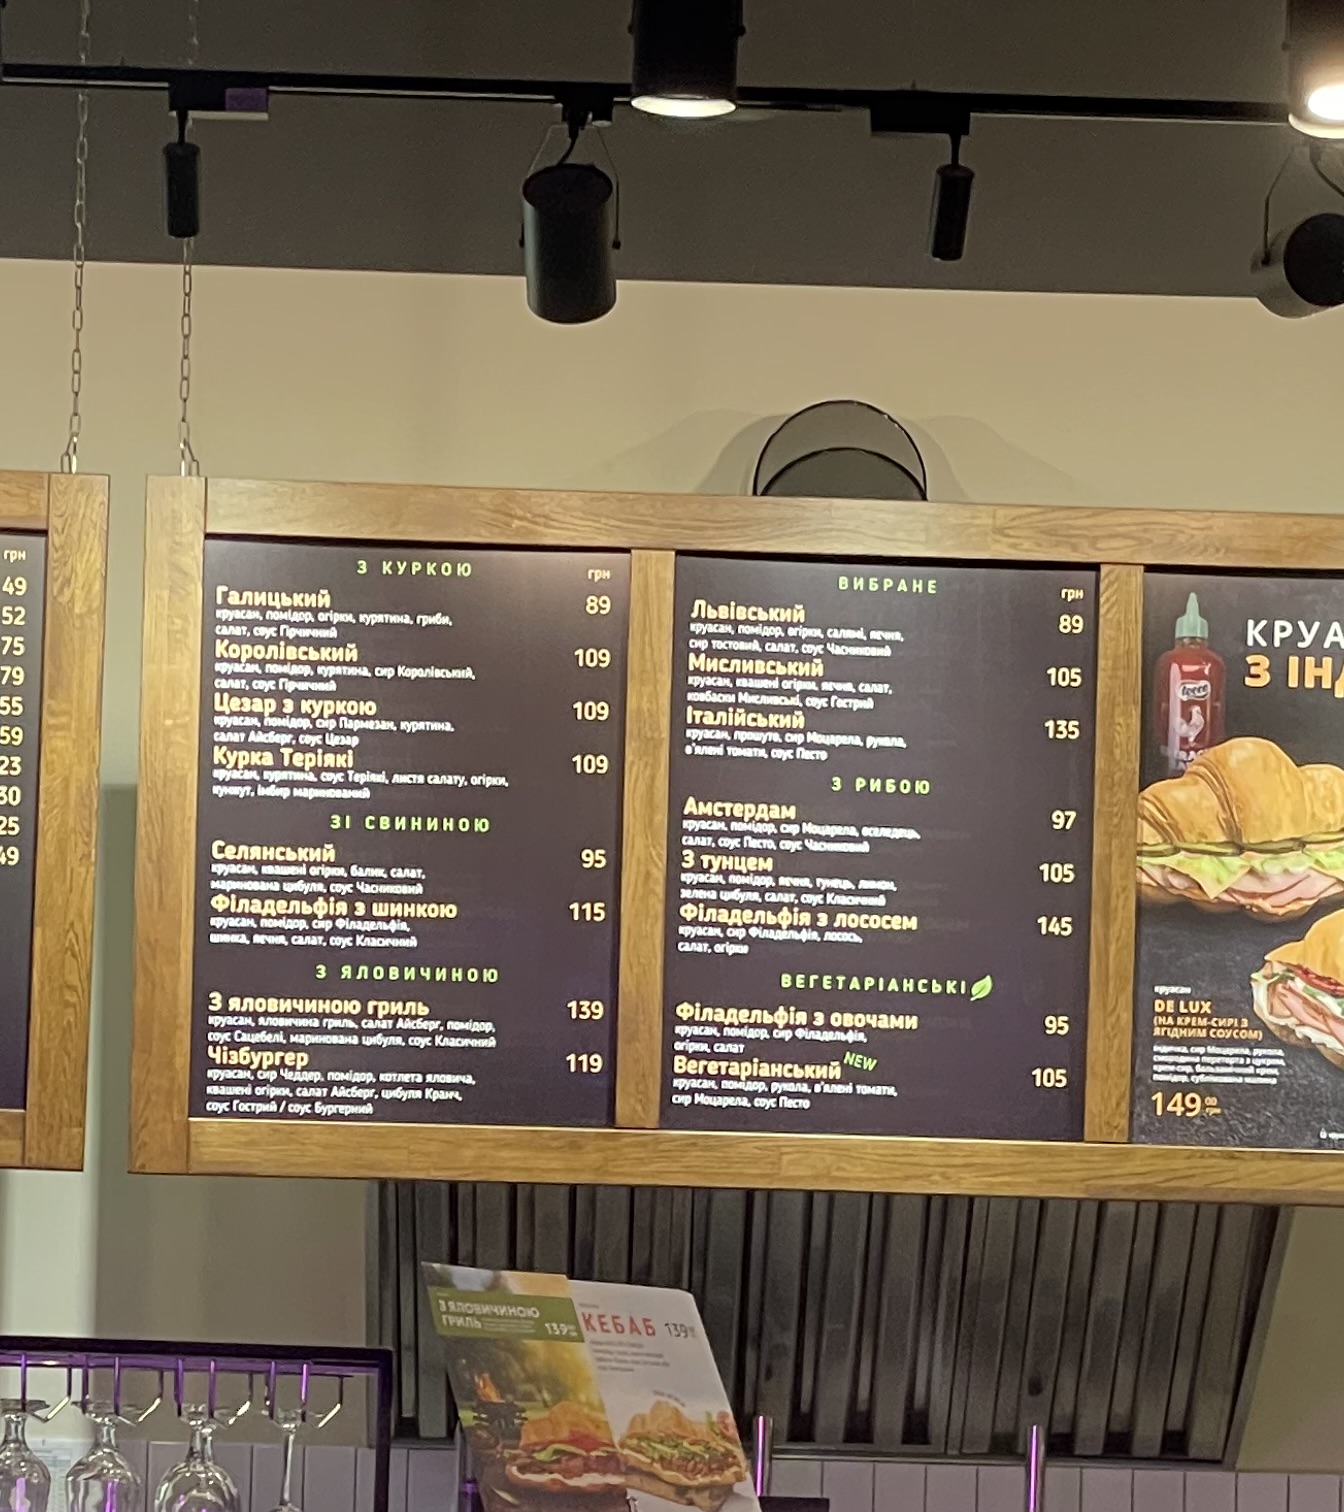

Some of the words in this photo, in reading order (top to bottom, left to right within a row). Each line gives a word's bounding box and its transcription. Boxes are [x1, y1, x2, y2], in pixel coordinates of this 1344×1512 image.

[4, 550, 26, 562] грн
[383, 561, 471, 576] КУРКОЮ
[588, 569, 610, 582] грн
[2, 576, 26, 595] 49
[839, 576, 936, 593] ВИБРАНЕ
[217, 585, 330, 609] Галицький
[1062, 589, 1083, 601] грн
[586, 596, 610, 614] 89
[691, 600, 805, 623] Львівський
[1059, 614, 1083, 633] 89
[1, 636, 25, 655] 75
[215, 639, 358, 666] Королівський
[575, 648, 610, 667] 109
[689, 653, 823, 676] Мисливський
[1, 666, 24, 685] 79
[1047, 667, 1081, 686] 105
[1245, 655, 1270, 686] З
[0, 696, 23, 715] 55
[214, 692, 280, 719] Цезар
[283, 699, 294, 713] з
[301, 699, 376, 718] куркою
[573, 701, 609, 720] 109
[687, 706, 805, 729] Італійський
[0, 726, 23, 745] 59
[1045, 720, 1079, 739] 135
[213, 746, 274, 772] Курка
[280, 748, 353, 771] Теріякі
[572, 755, 608, 773] 109
[684, 796, 796, 822] Амстердам
[365, 816, 489, 832] СВИНИНОЮ
[1052, 810, 1076, 829] 97
[212, 840, 335, 862] Селянський
[582, 849, 606, 868] 95
[682, 849, 694, 868] З
[700, 855, 773, 873] тунцем
[1040, 863, 1074, 882] 105
[211, 894, 347, 919] Філадельфія
[354, 902, 365, 916] з
[372, 903, 457, 918] шинкою
[570, 903, 605, 921] 115
[782, 974, 965, 994] ВЕГЕТАРІАНСЬКІ
[1155, 1000, 1174, 1013] DE
[1180, 1000, 1211, 1013] LUX
[208, 1046, 309, 1070] Чізбургер
[566, 1054, 602, 1072] 119
[844, 1052, 877, 1070] NEW
[674, 1055, 841, 1081] Вегетаріанський
[1032, 1068, 1067, 1087] 105
[1152, 1092, 1201, 1116] 149
[449, 1301, 539, 1318] ЯЛОВИЧИНОЮ
[442, 1316, 482, 1329] ГРИЛЬ
[582, 1312, 656, 1336] КЕБАБ
